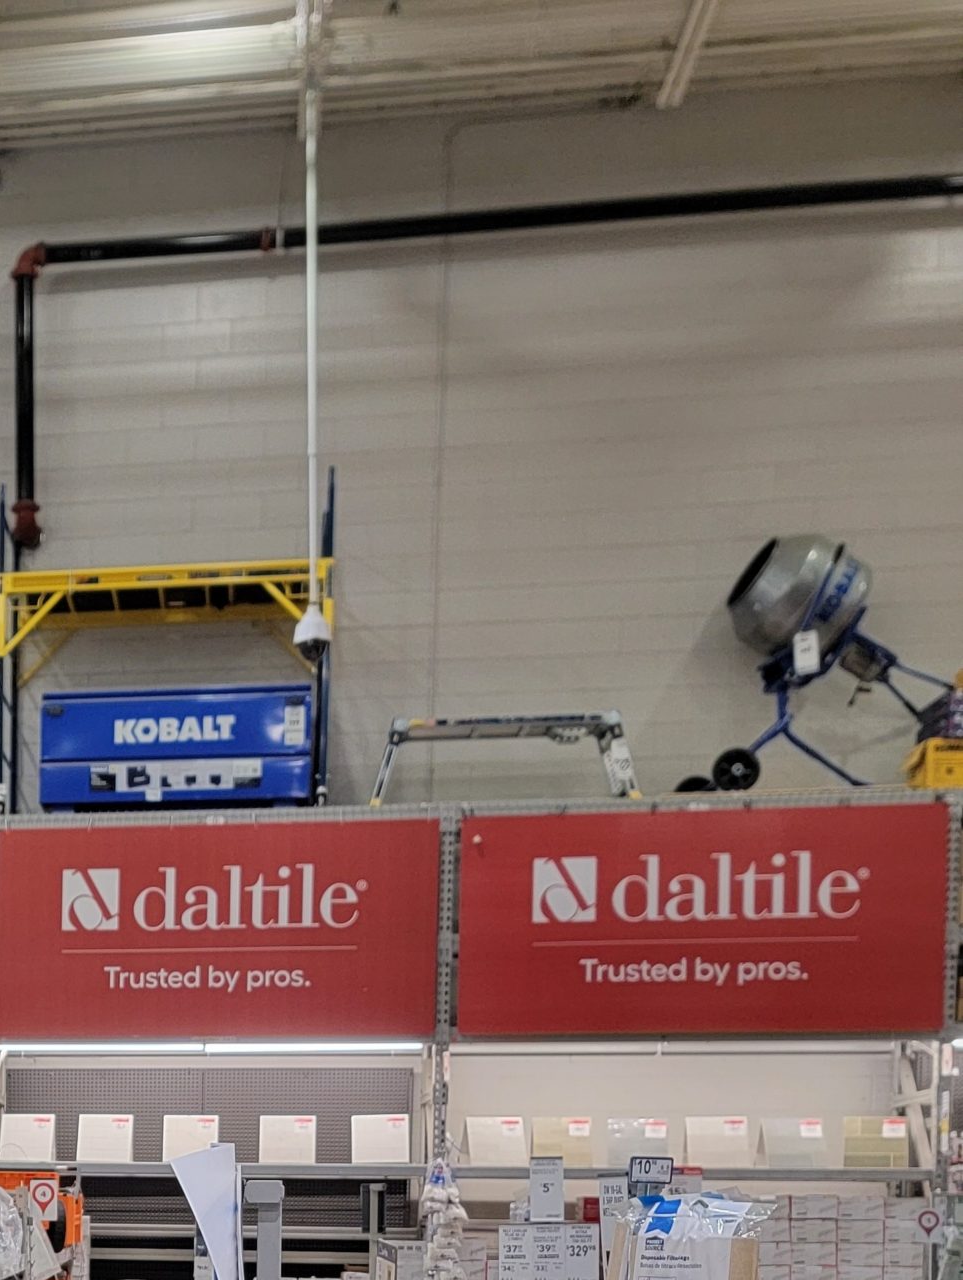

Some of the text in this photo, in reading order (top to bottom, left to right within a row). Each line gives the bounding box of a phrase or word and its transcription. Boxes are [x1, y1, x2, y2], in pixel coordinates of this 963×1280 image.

[113, 714, 236, 744] KOBALT
[133, 864, 363, 932] daltile
[612, 850, 864, 923] daltile
[104, 966, 311, 992] Trusted by pros.
[579, 958, 808, 986] Trusted by pros.
[40, 1190, 47, 1198] 4
